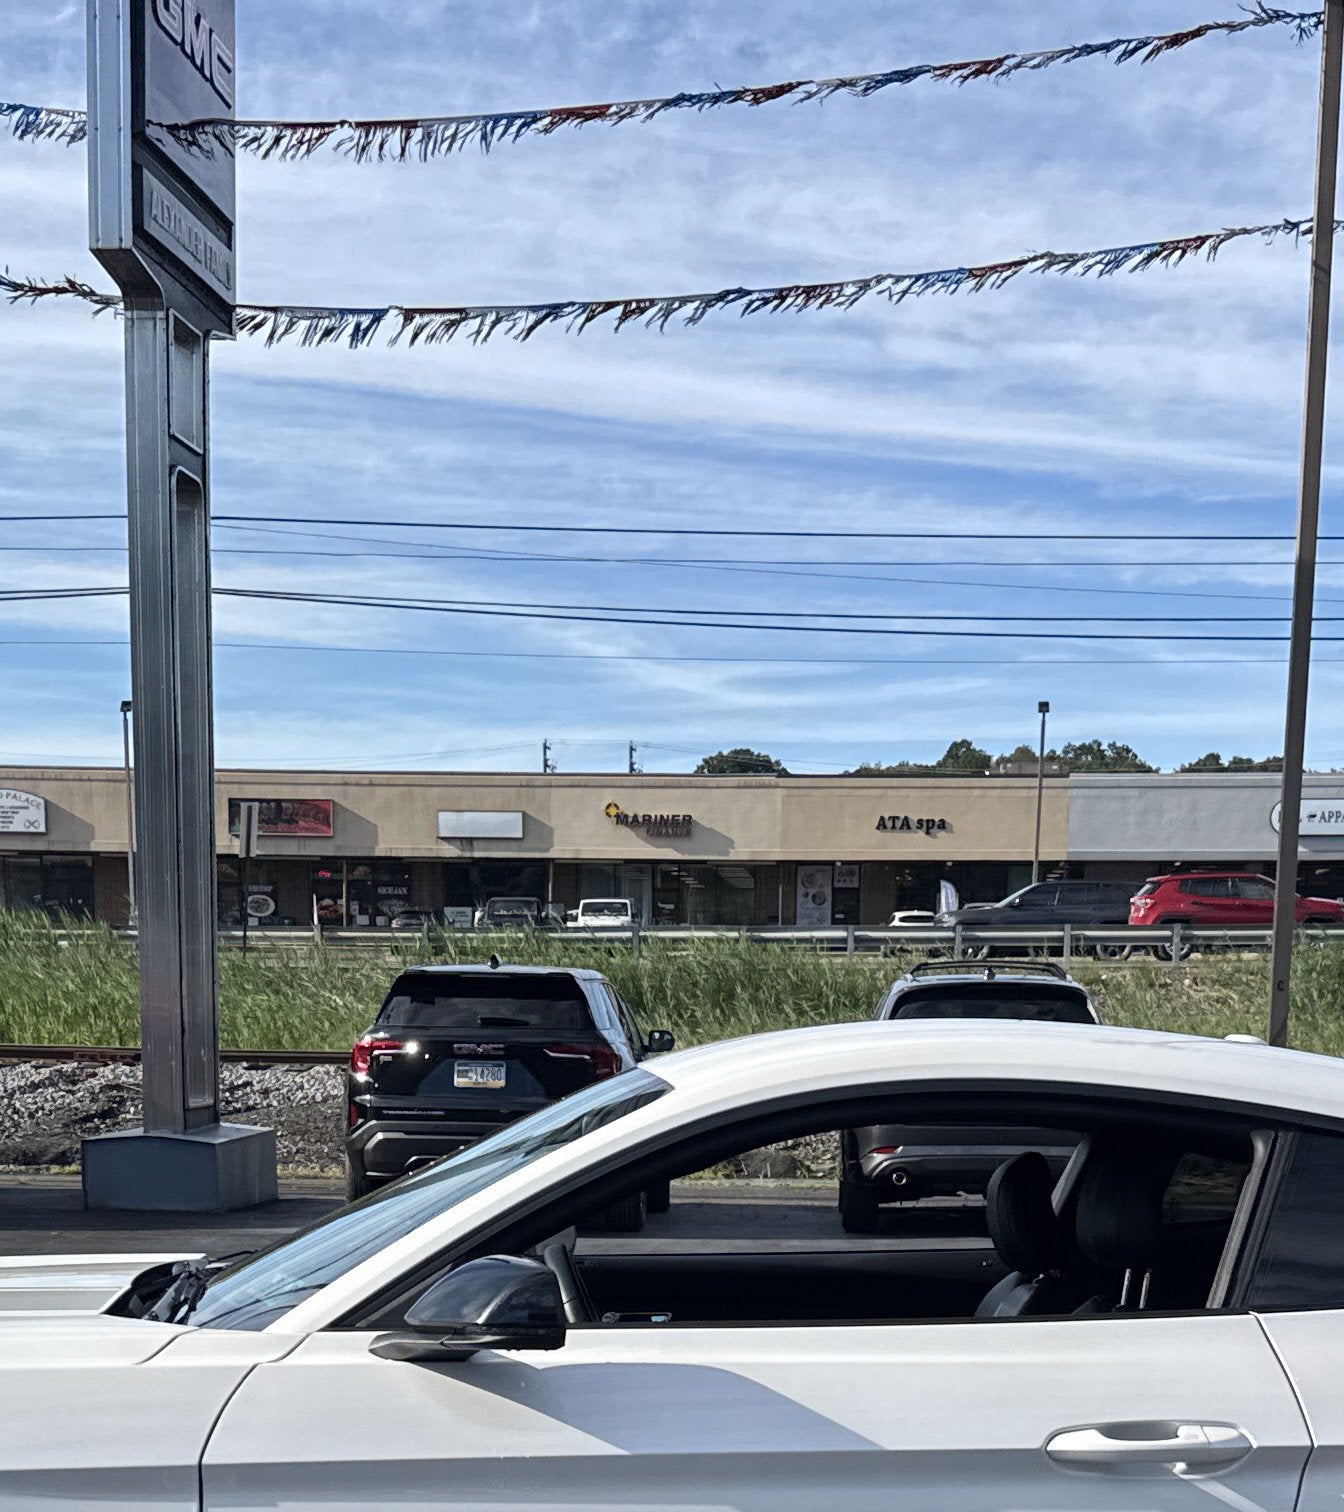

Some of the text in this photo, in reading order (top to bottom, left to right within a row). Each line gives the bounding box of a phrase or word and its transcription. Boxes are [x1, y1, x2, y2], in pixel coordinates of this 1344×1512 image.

[5, 792, 43, 810] PALACE
[615, 812, 693, 826] MARINER
[875, 815, 947, 835] ATA spa
